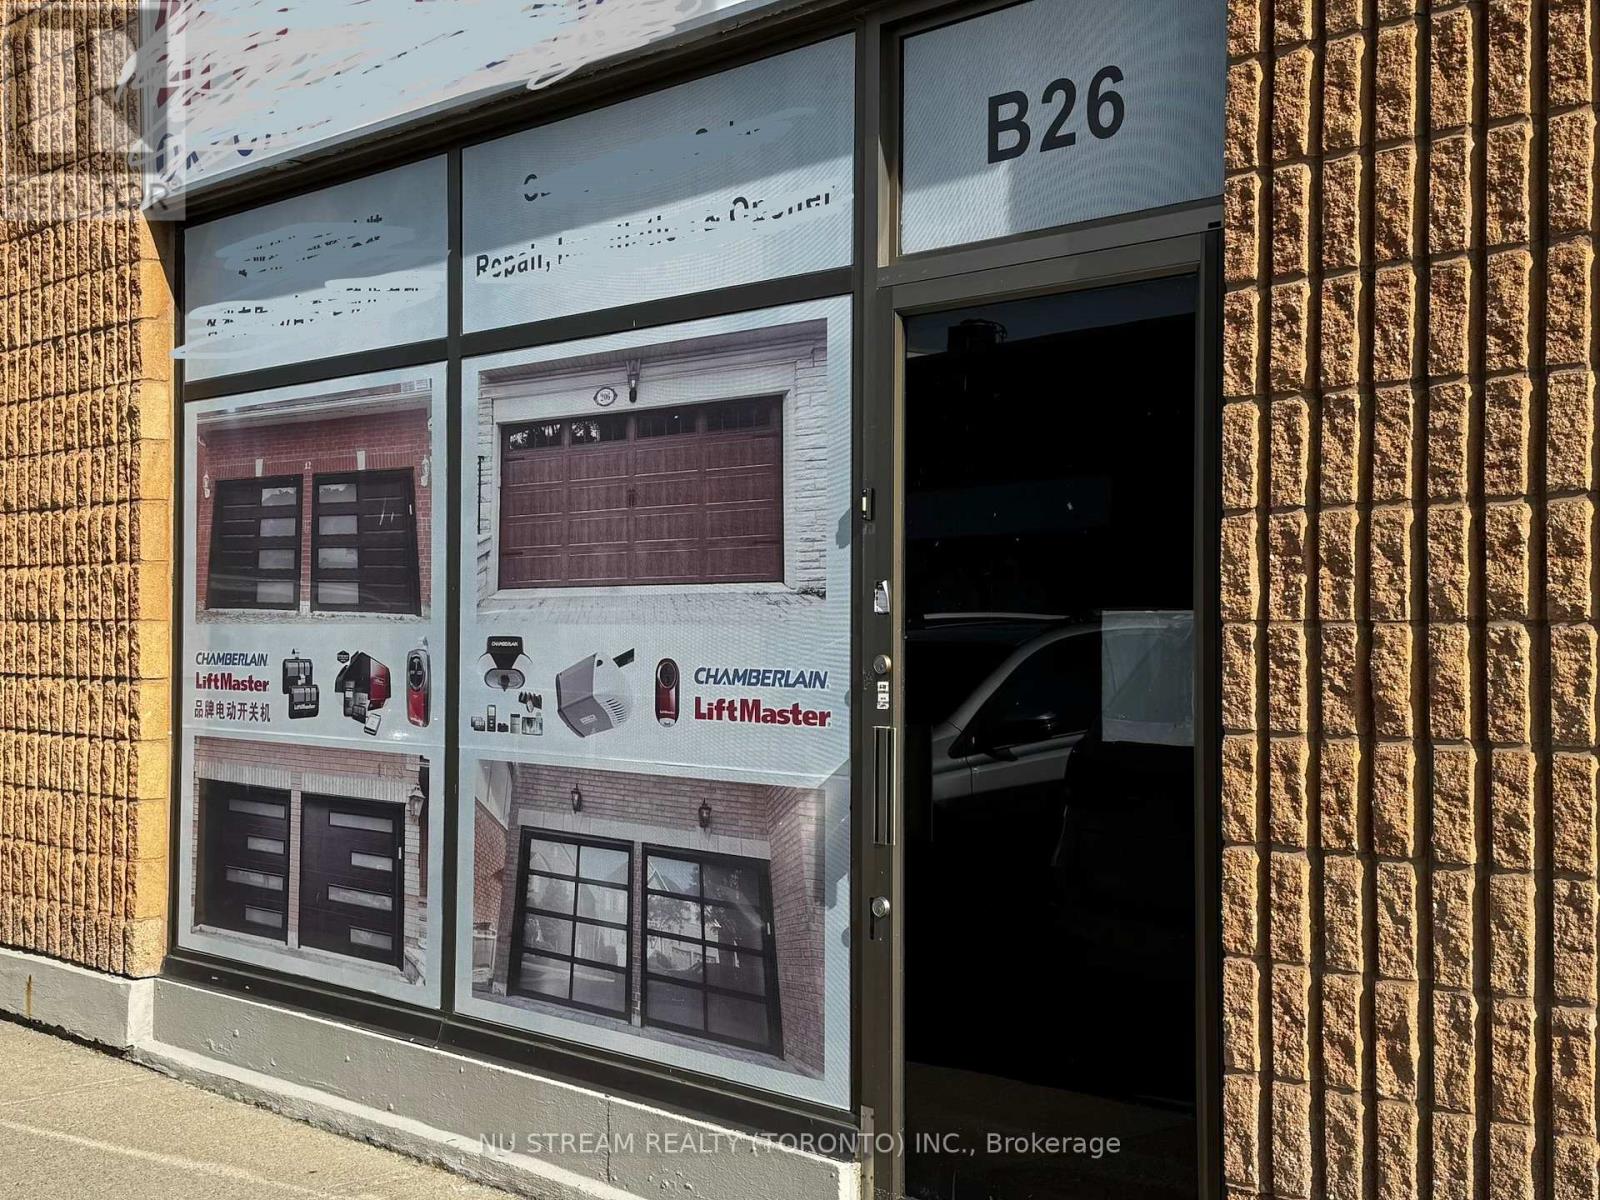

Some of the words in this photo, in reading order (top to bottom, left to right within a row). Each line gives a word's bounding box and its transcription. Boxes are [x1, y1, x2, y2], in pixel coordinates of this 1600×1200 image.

[988, 65, 1125, 165] B26
[195, 652, 269, 667] CHAMBERLAIN
[195, 671, 270, 692] LiftMaster
[694, 667, 829, 689] CHAMBERLAIN
[194, 700, 271, 723] 品牌电动开关机
[694, 696, 831, 727] LiftMaster
